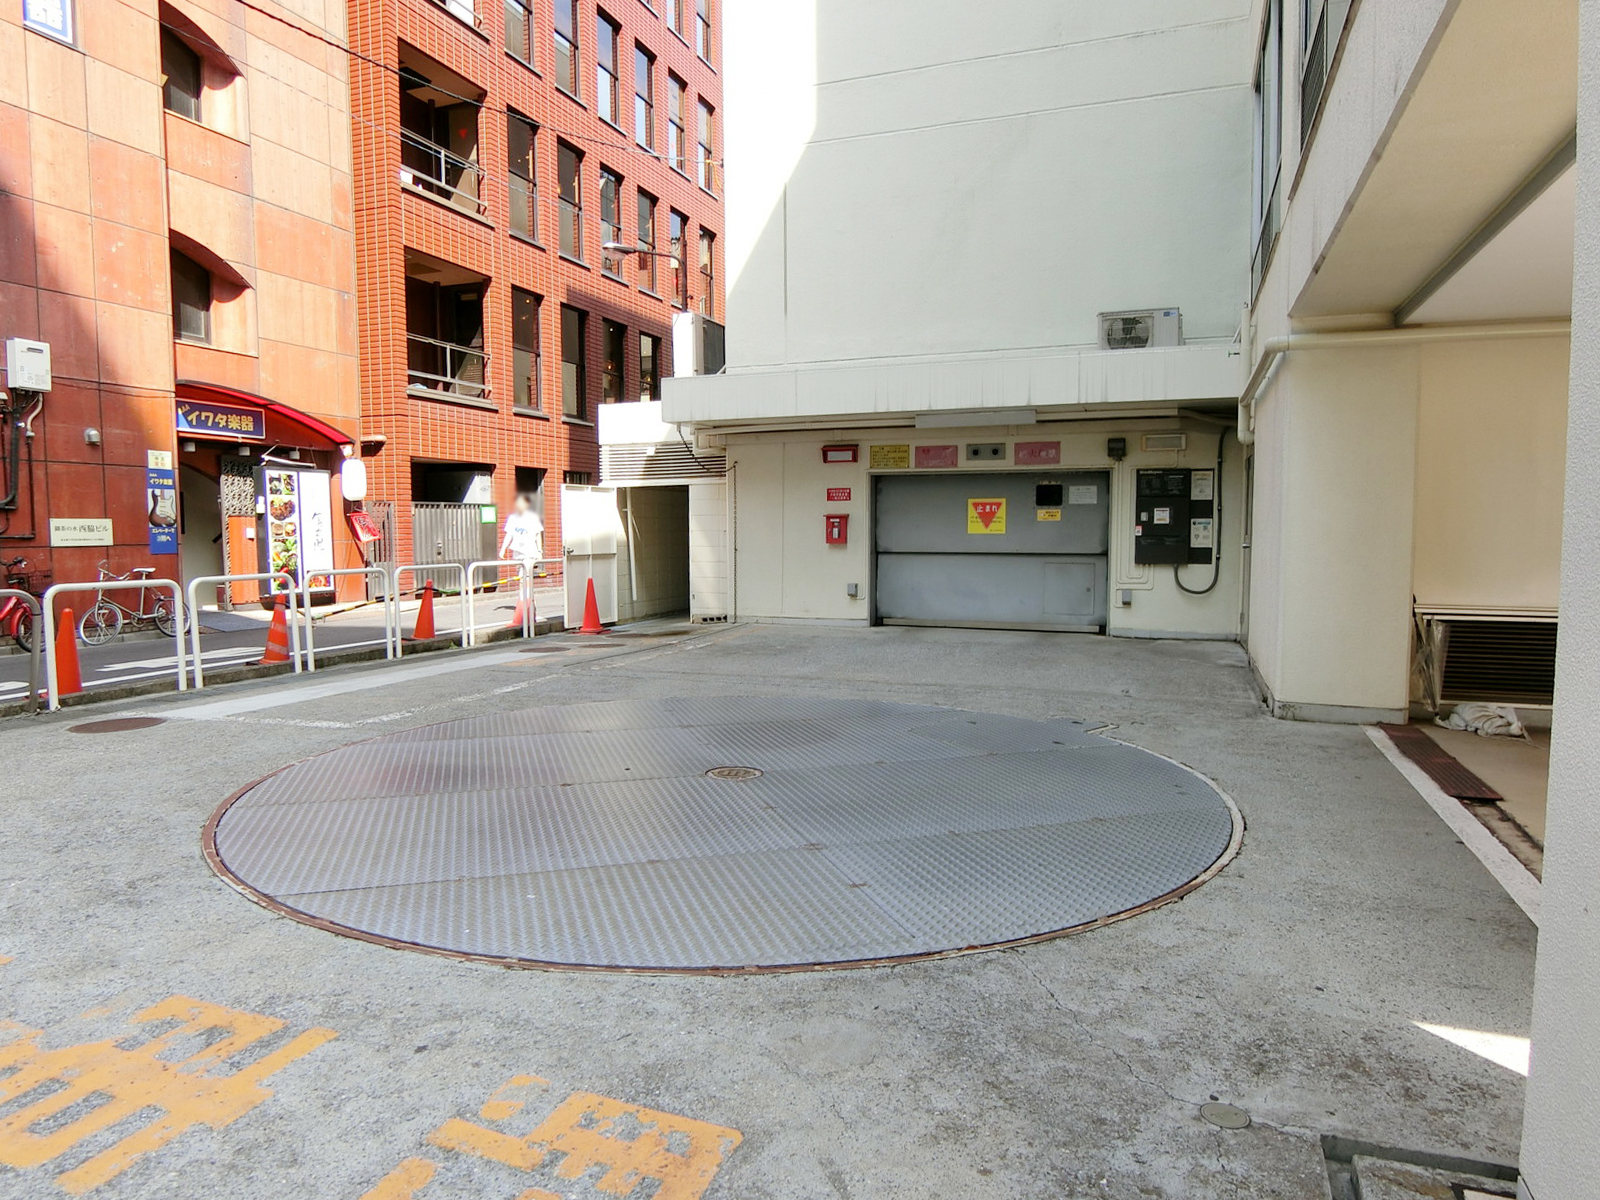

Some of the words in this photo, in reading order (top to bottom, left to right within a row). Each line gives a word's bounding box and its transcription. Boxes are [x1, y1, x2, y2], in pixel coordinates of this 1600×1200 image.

[187, 410, 254, 432] イワタ楽器
[976, 504, 998, 513] 止まれ
